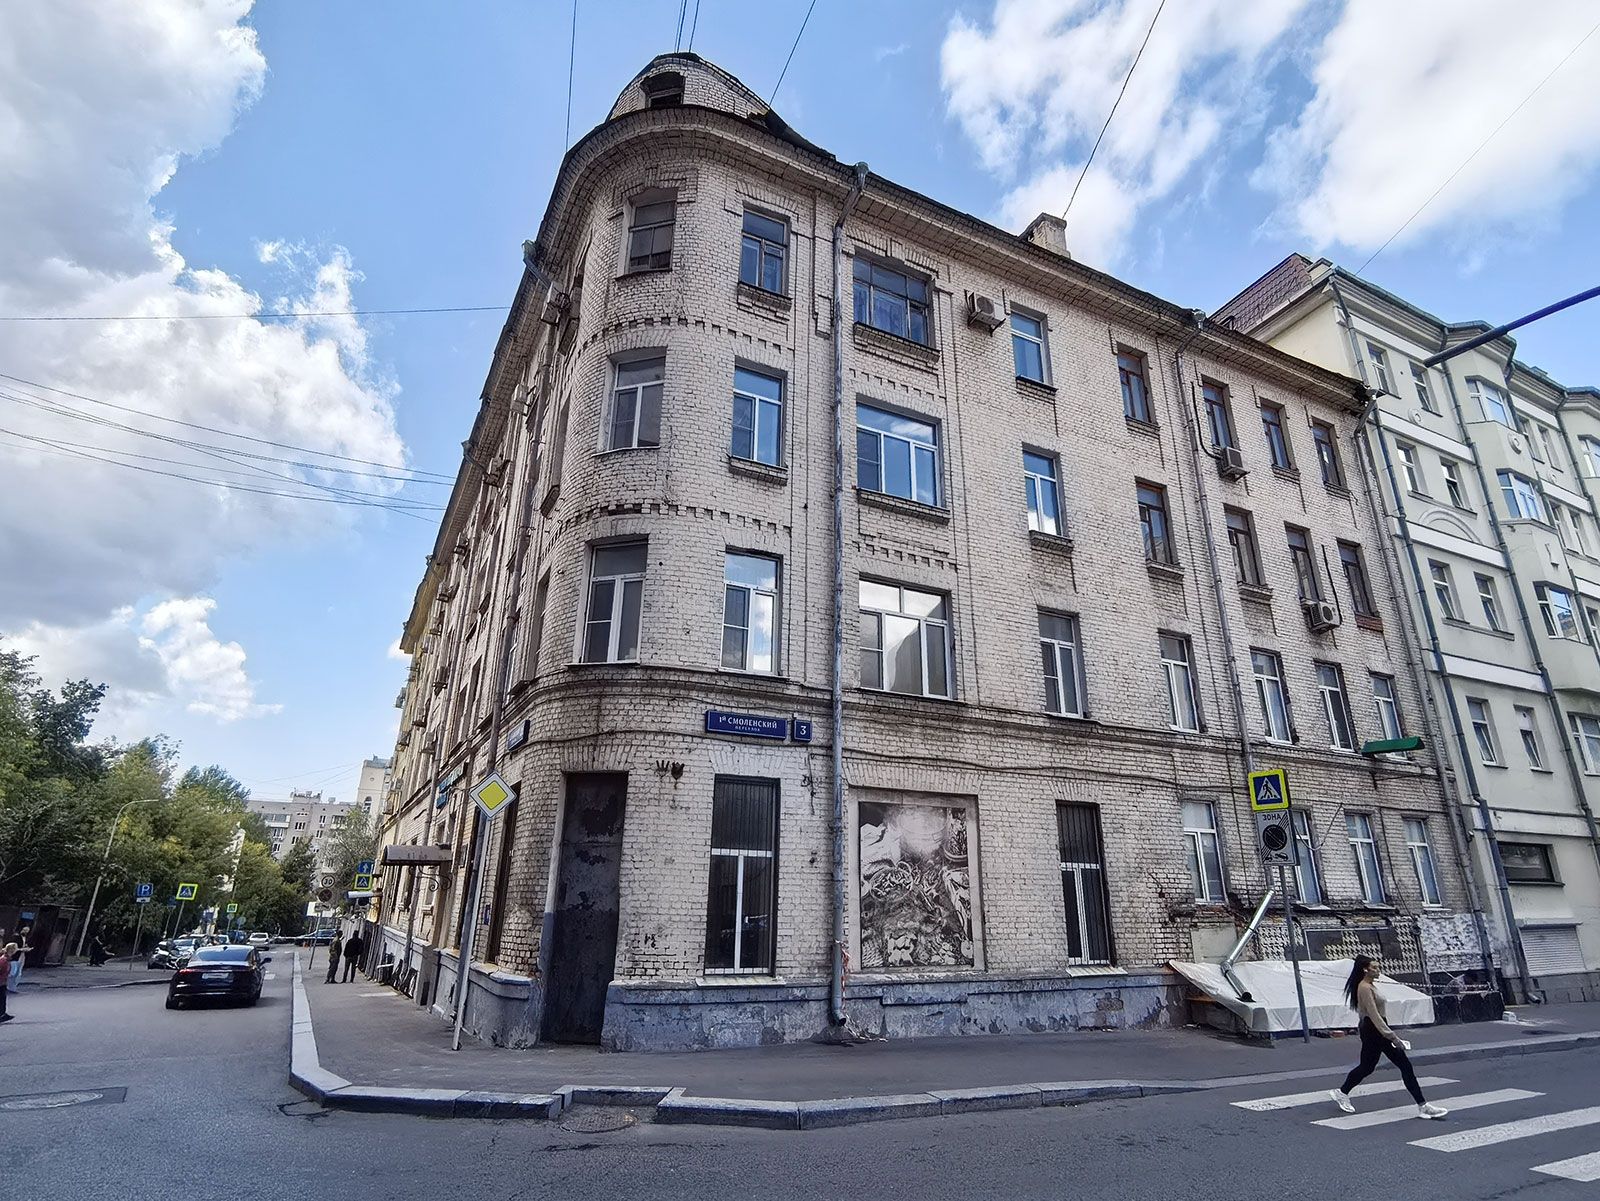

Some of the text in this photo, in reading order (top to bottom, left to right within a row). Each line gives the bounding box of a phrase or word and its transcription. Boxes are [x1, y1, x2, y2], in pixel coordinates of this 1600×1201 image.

[728, 716, 778, 729] СМОЛЕНСКИЙ
[800, 725, 807, 735] 3
[1263, 813, 1281, 821] ЗОНА
